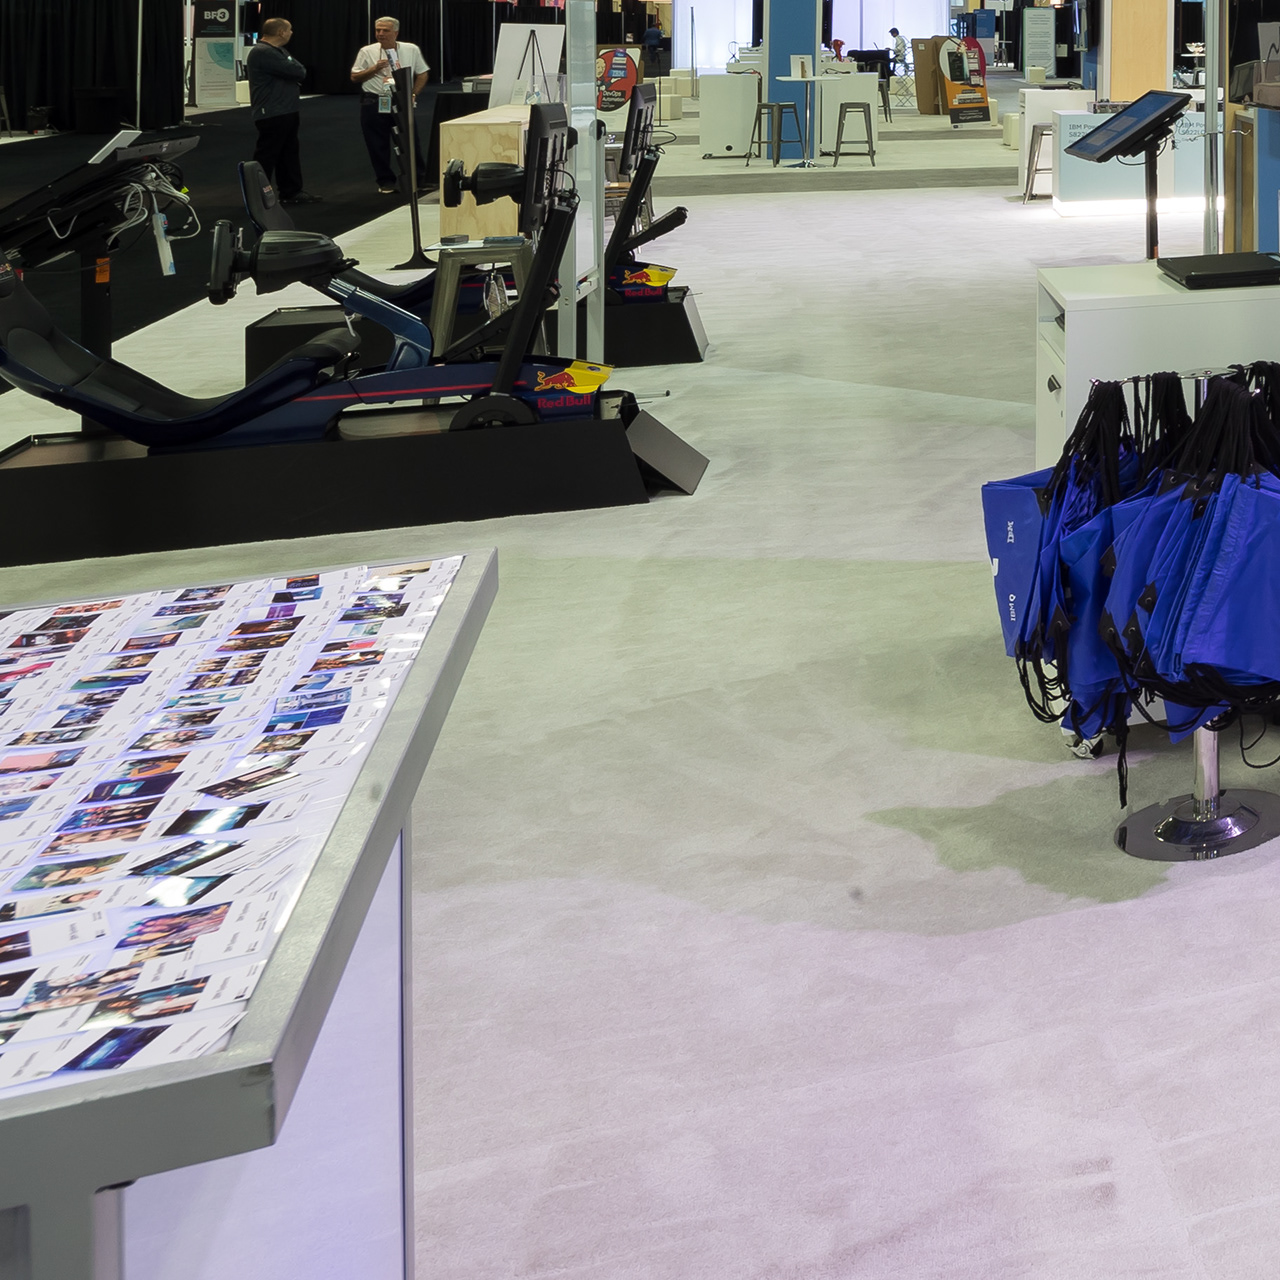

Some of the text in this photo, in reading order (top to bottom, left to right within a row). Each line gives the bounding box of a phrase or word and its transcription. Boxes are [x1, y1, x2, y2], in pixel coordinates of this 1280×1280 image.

[624, 287, 663, 297] Red Bull
[537, 394, 591, 409] Red Bull
[1007, 521, 1015, 543] IBM
